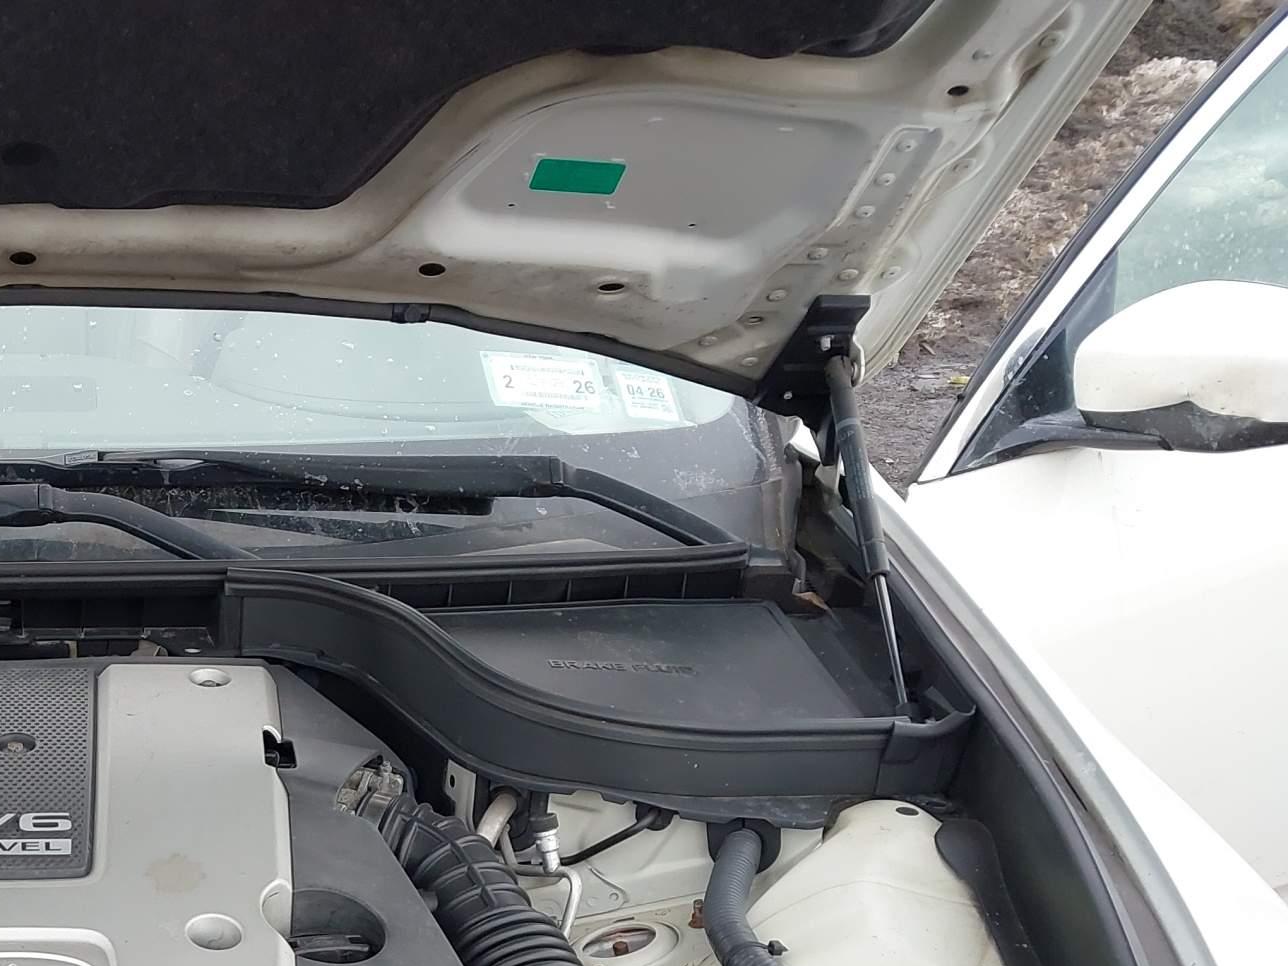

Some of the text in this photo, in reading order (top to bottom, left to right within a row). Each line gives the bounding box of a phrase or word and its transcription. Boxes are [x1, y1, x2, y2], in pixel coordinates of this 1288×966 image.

[502, 374, 514, 389] 2
[573, 379, 596, 395] 26
[546, 659, 697, 675] BRAKE FLUID
